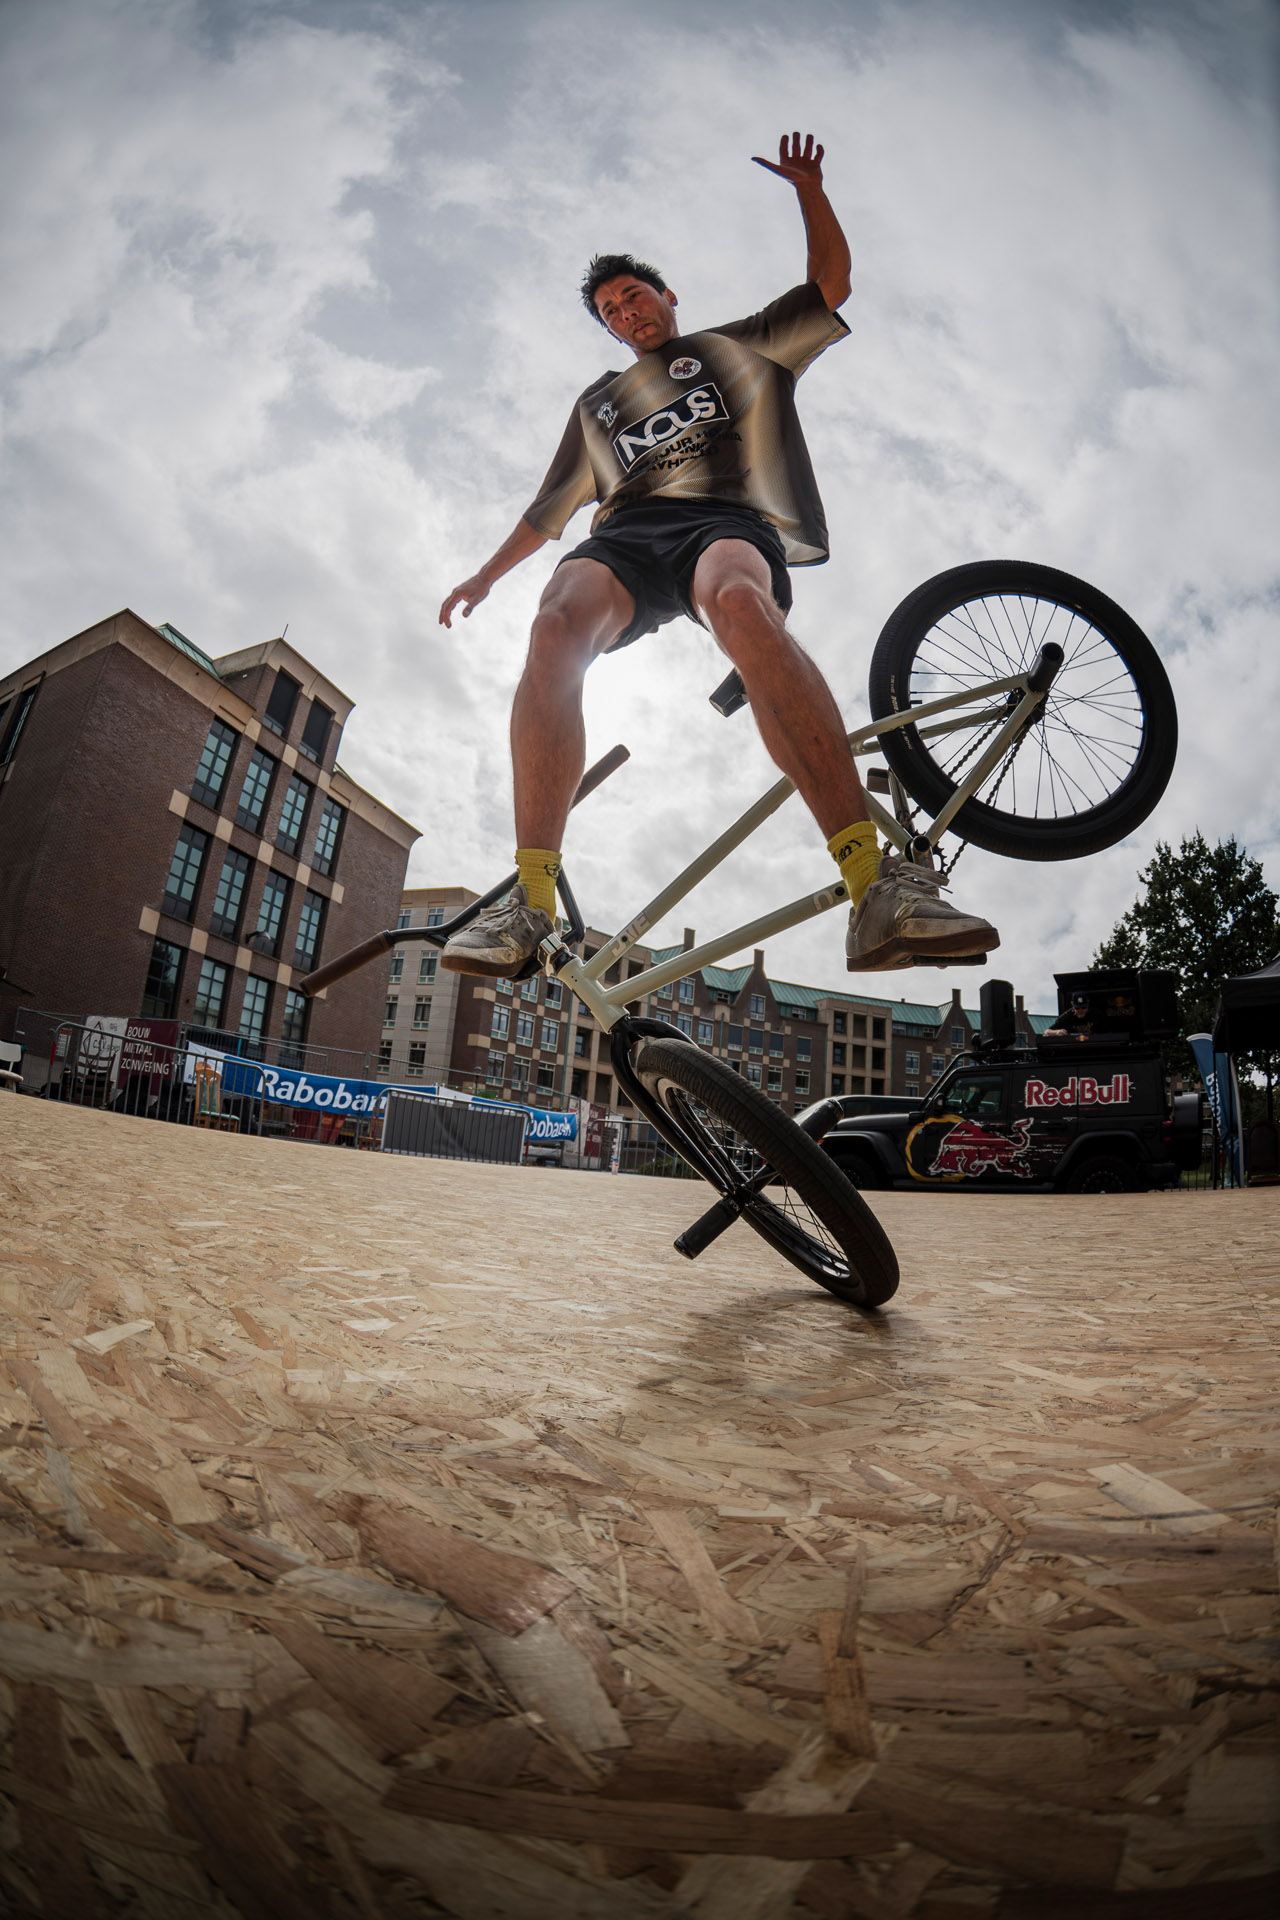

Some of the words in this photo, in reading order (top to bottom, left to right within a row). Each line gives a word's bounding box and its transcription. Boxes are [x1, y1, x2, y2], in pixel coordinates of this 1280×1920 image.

[617, 389, 717, 464] NOUS
[127, 1026, 151, 1039] BOUW
[256, 1068, 388, 1113] Raboban
[1025, 1077, 1077, 1107] Red
[1078, 1074, 1130, 1105] Bull
